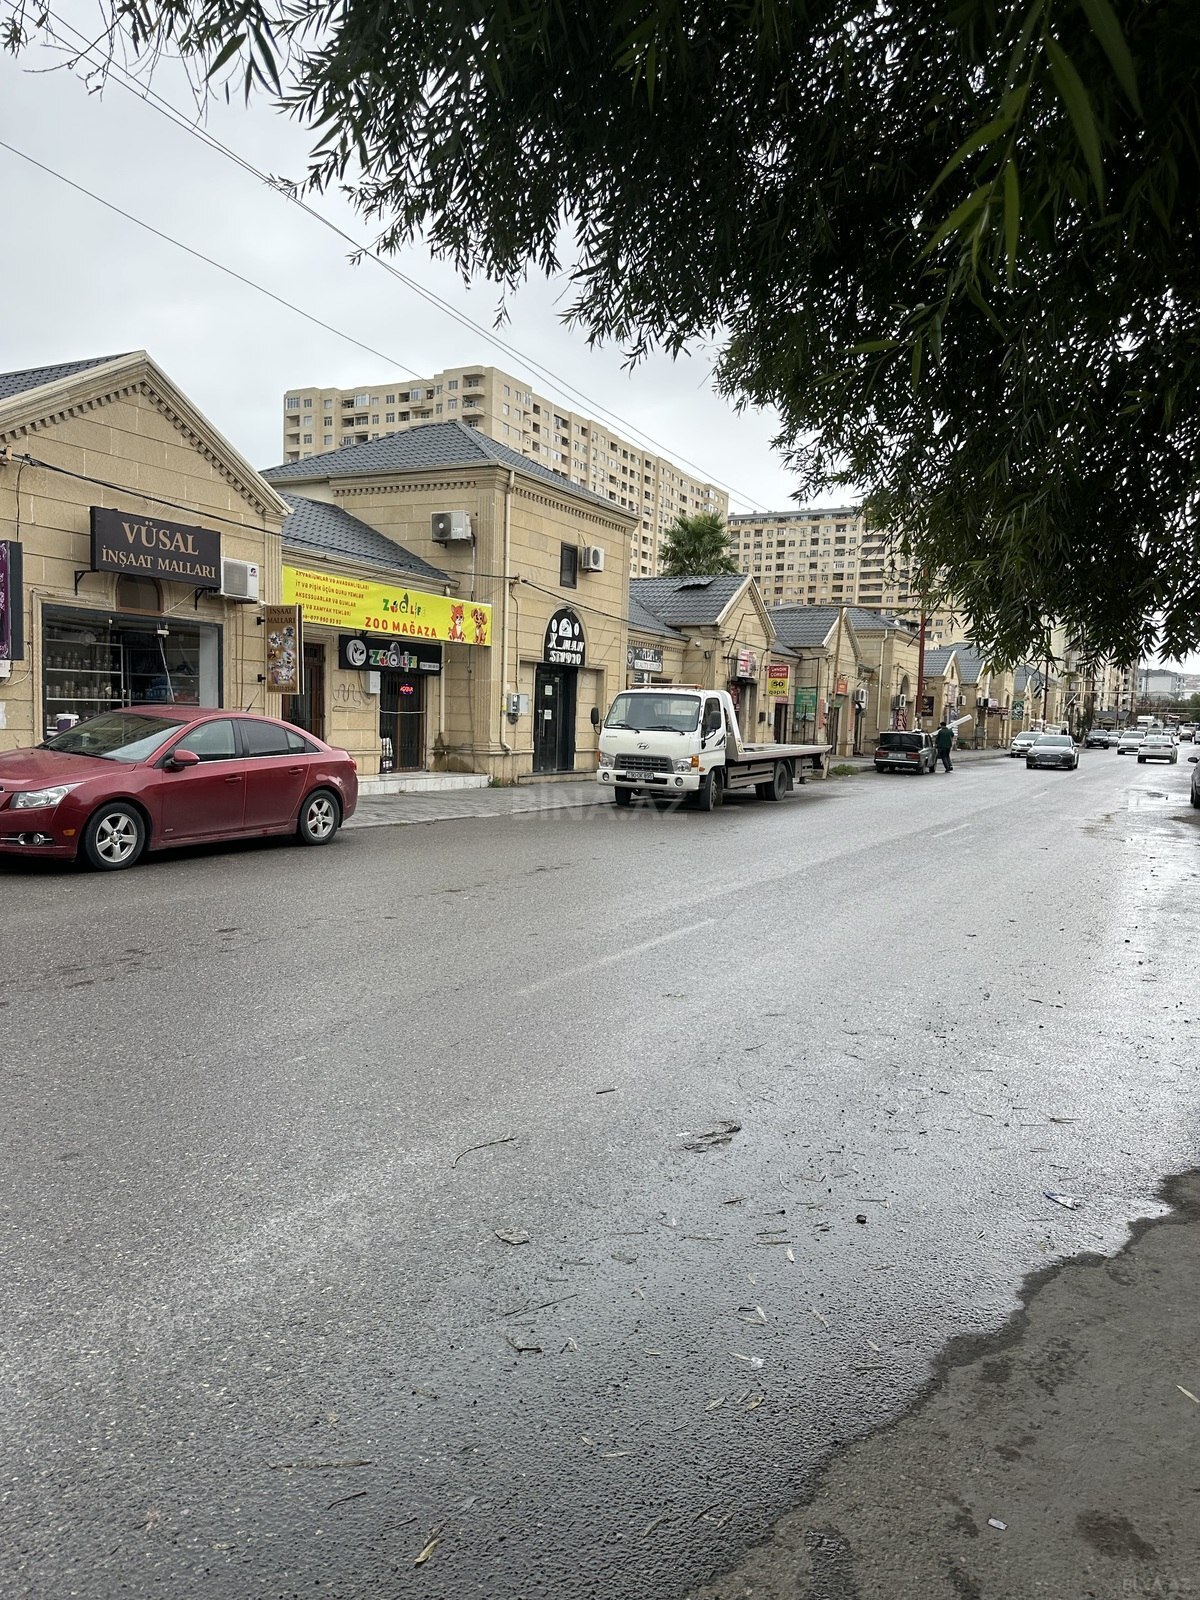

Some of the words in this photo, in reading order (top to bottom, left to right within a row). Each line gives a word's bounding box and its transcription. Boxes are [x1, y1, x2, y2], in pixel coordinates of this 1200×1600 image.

[122, 521, 198, 554] VÜSAL
[102, 545, 153, 568] İNŞAAT
[158, 559, 216, 578] MALLARI
[365, 617, 388, 630] ZOO
[392, 621, 437, 638] MAĞAZA
[549, 651, 581, 664] STUDIO
